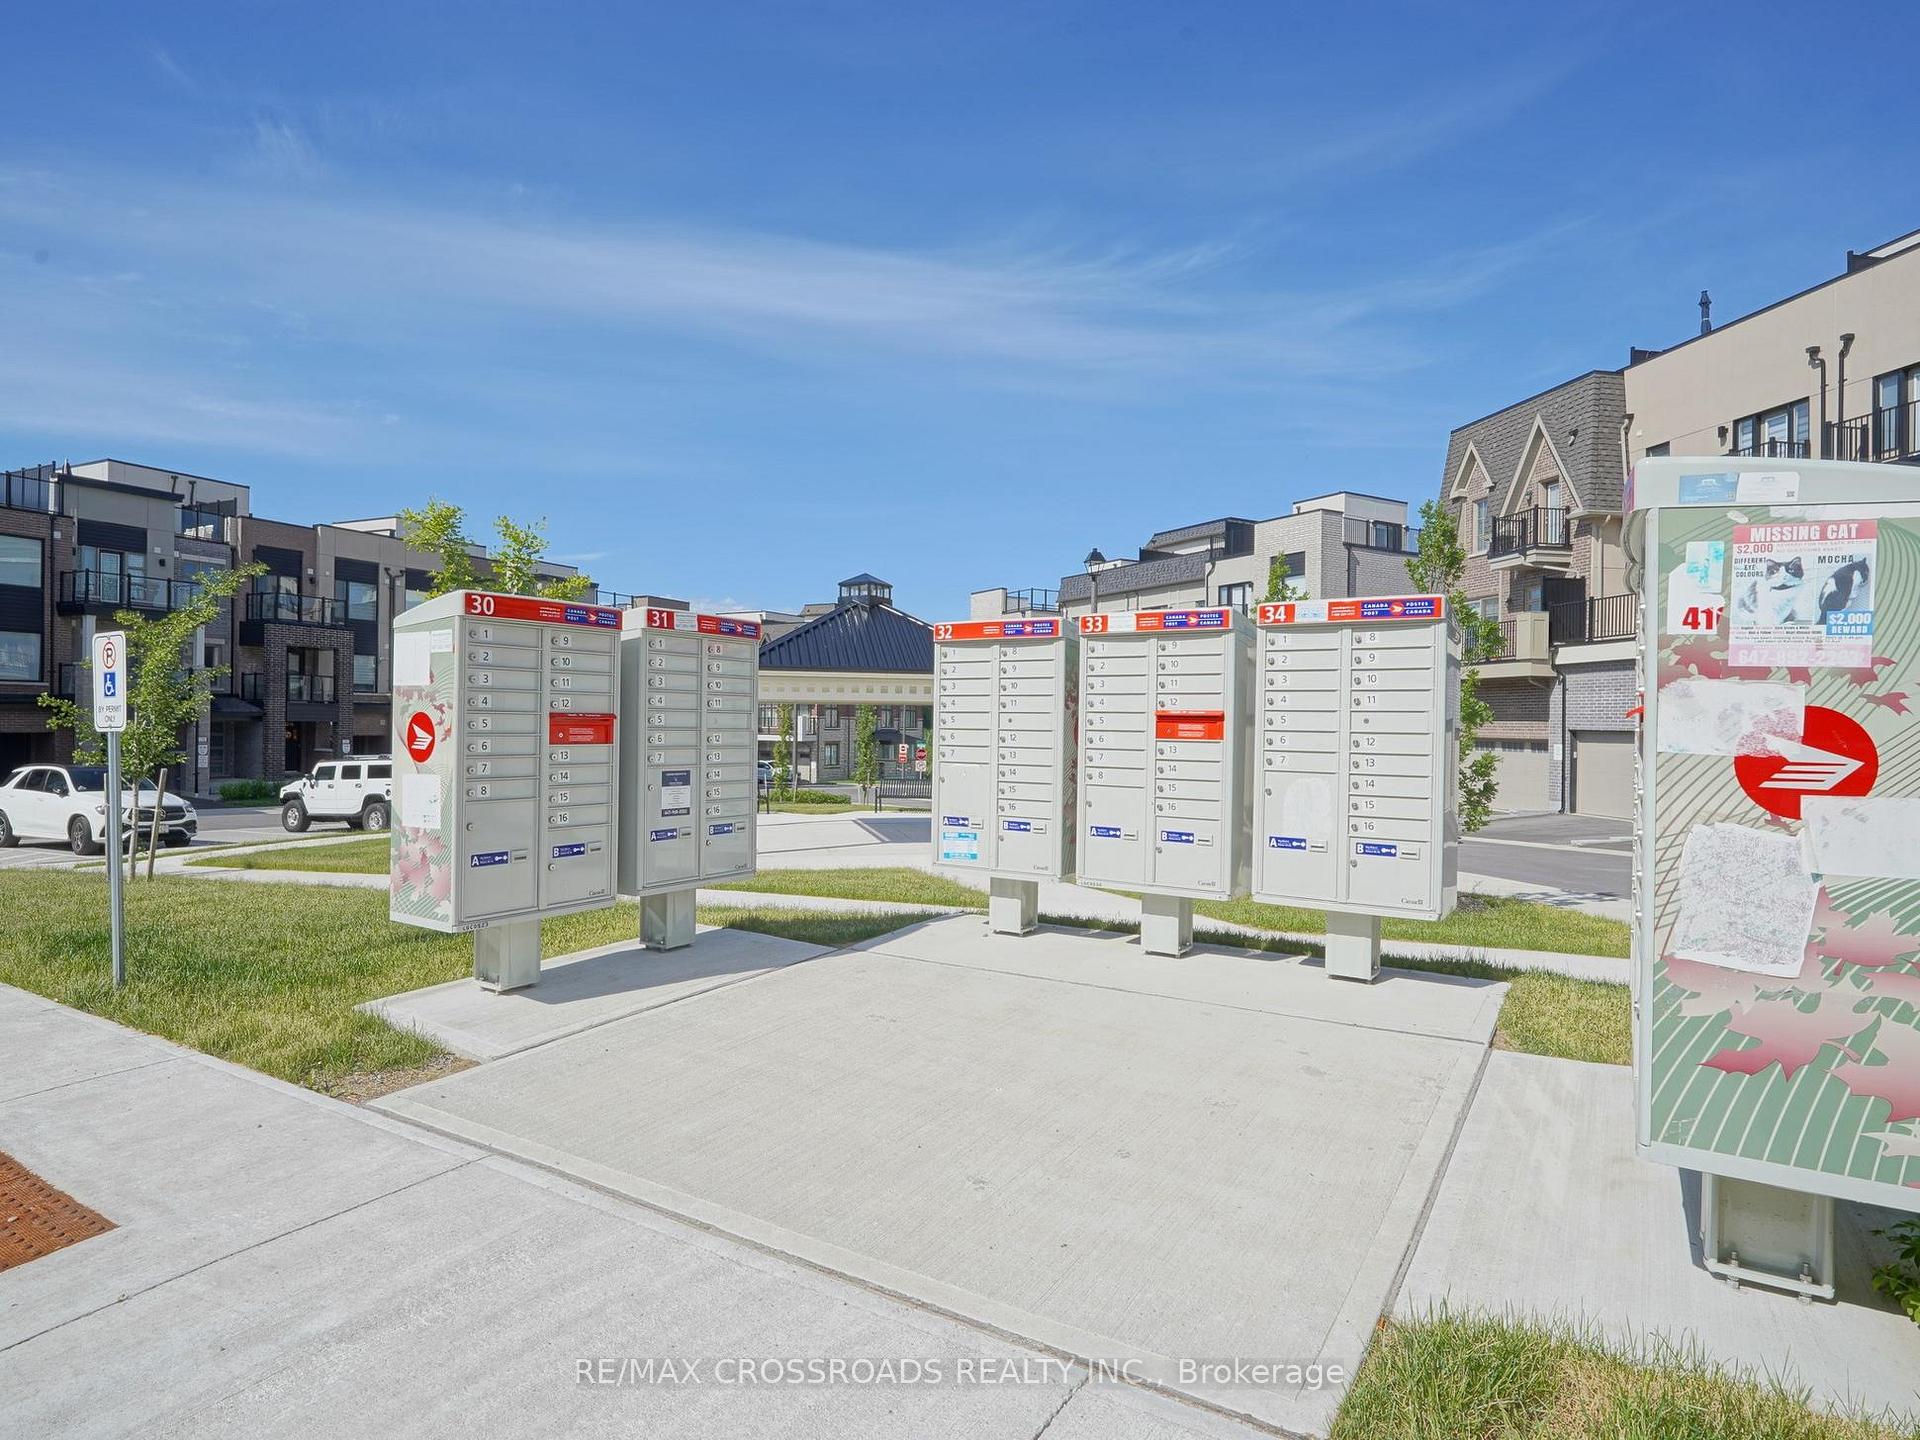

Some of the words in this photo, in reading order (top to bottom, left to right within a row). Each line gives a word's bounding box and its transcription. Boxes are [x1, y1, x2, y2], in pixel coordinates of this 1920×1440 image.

[1750, 525, 1820, 542] MISSING
[1827, 523, 1858, 539] CAT
[1737, 544, 1773, 554] $2,000
[1817, 555, 1854, 564] MOCHA
[470, 596, 494, 615] 30
[1264, 606, 1286, 622] 34
[1828, 612, 1872, 625] $2,000
[651, 611, 668, 628] 31
[1084, 617, 1103, 632] 33
[937, 625, 952, 639] 32
[1832, 625, 1868, 634] REWARD
[563, 636, 569, 645] 9
[1369, 633, 1376, 641] 8
[562, 657, 570, 666] 10
[1369, 653, 1375, 662] 9
[562, 678, 570, 687] 11
[1171, 679, 1178, 687] 11
[1368, 675, 1377, 683] 10
[561, 699, 570, 708] 12
[1011, 699, 1017, 707] 11
[1367, 696, 1376, 704] 11
[104, 715, 116, 723] ONLY
[1366, 737, 1375, 746] 12
[560, 751, 569, 760] 13
[1365, 759, 1375, 767] 13
[559, 772, 569, 781] 14
[1168, 784, 1176, 792] 15
[1365, 780, 1375, 788] 14
[559, 793, 568, 801] 15
[1168, 803, 1176, 811] 16
[1364, 801, 1374, 809] 15
[559, 813, 568, 822] 16
[943, 817, 949, 826] A
[709, 826, 714, 834] B
[1364, 822, 1374, 830] 16
[1091, 827, 1097, 836] A
[1162, 832, 1168, 840] B
[1270, 838, 1277, 847] A
[553, 847, 559, 857] B
[1357, 844, 1364, 853] B
[471, 853, 480, 866] A
